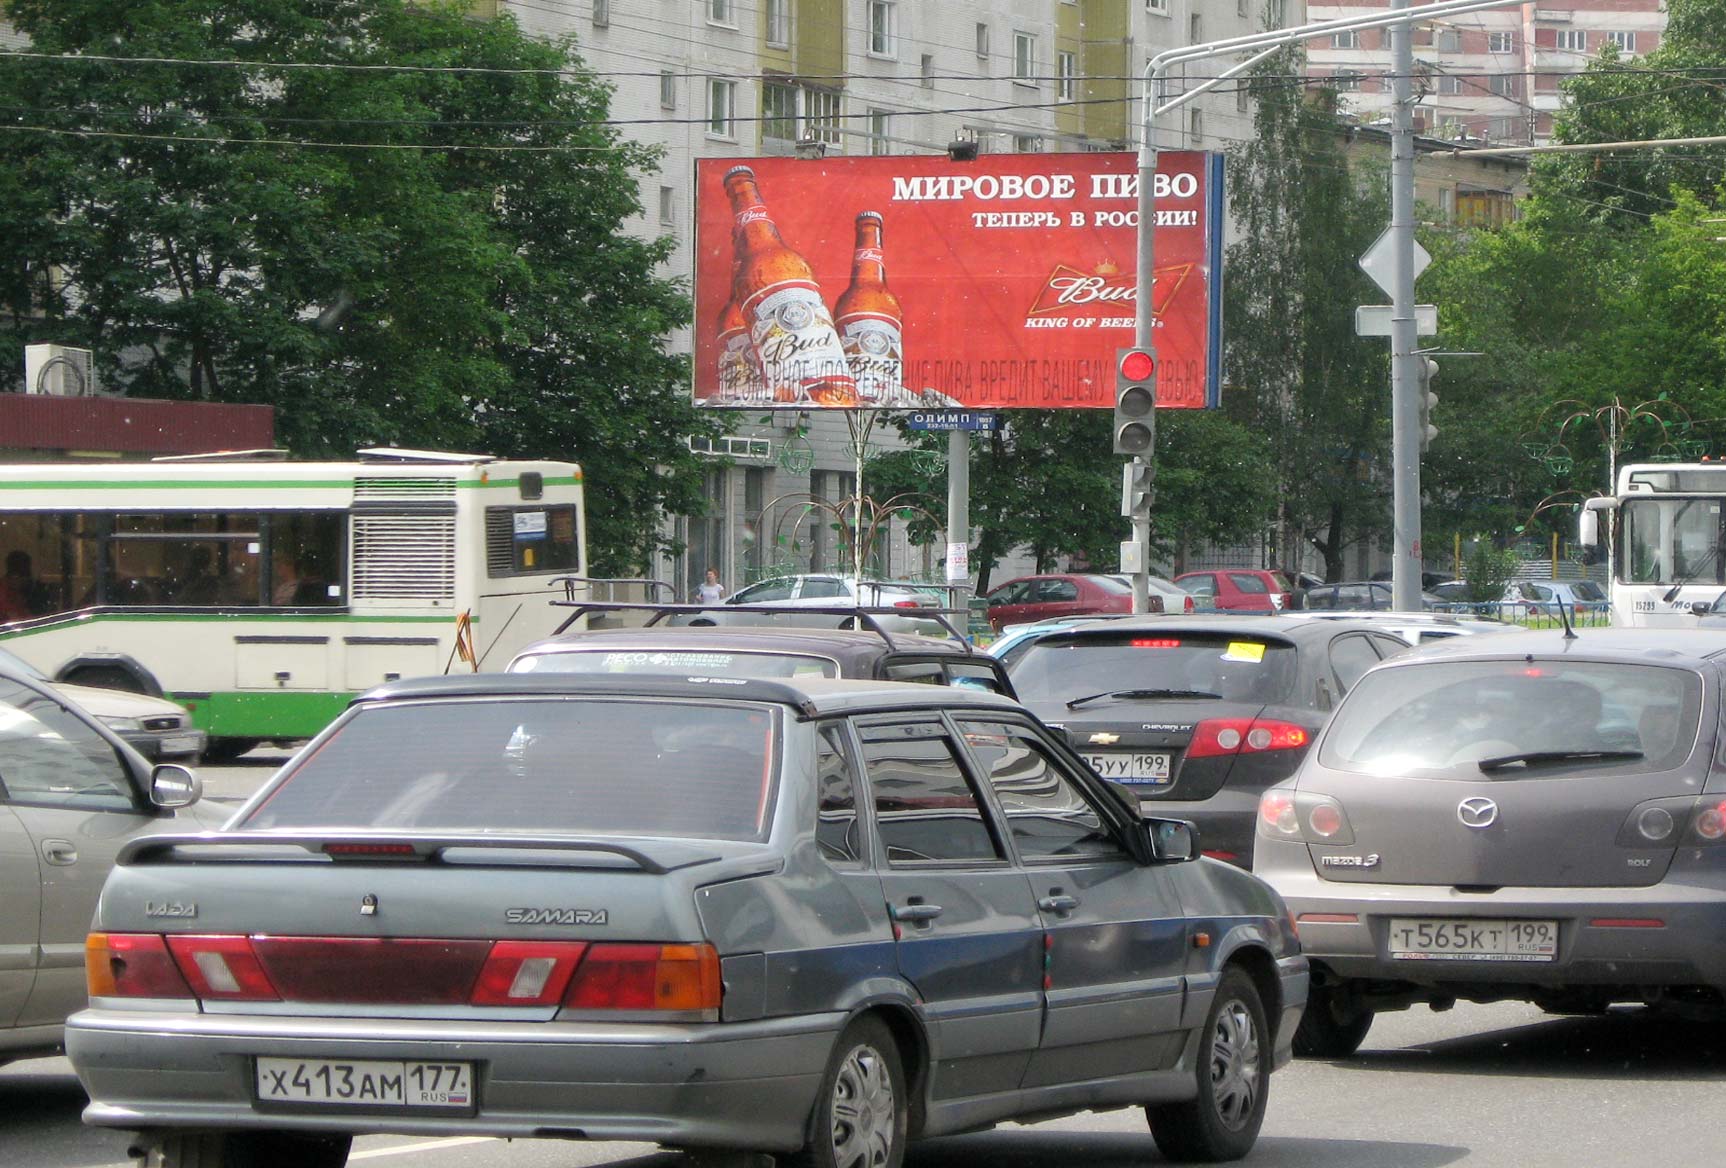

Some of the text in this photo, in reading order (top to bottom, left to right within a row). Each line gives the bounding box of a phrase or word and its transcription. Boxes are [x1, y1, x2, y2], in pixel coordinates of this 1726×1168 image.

[892, 173, 1198, 201] МИРОВОЕ ПИВО
[972, 210, 1198, 228] ТЕПЕРЬ В РОСИИ!
[1024, 317, 1069, 328] KING
[1072, 317, 1096, 328] OF
[763, 332, 833, 366] Bud
[934, 360, 972, 400] ПИВА
[980, 360, 1038, 403] ВРЕДИТ
[1043, 360, 1108, 401] ВАШЕМУ
[914, 413, 970, 423] ОЛИМП
[1142, 724, 1193, 732] CHEVROLET
[1135, 755, 1165, 770] 199
[145, 902, 198, 918] LADA
[505, 908, 608, 925] SAMARA
[1511, 923, 1549, 943] 199
[1518, 943, 1538, 951] RUS
[269, 1063, 462, 1100] Х413АМ 177
[421, 1091, 447, 1102] RUS
